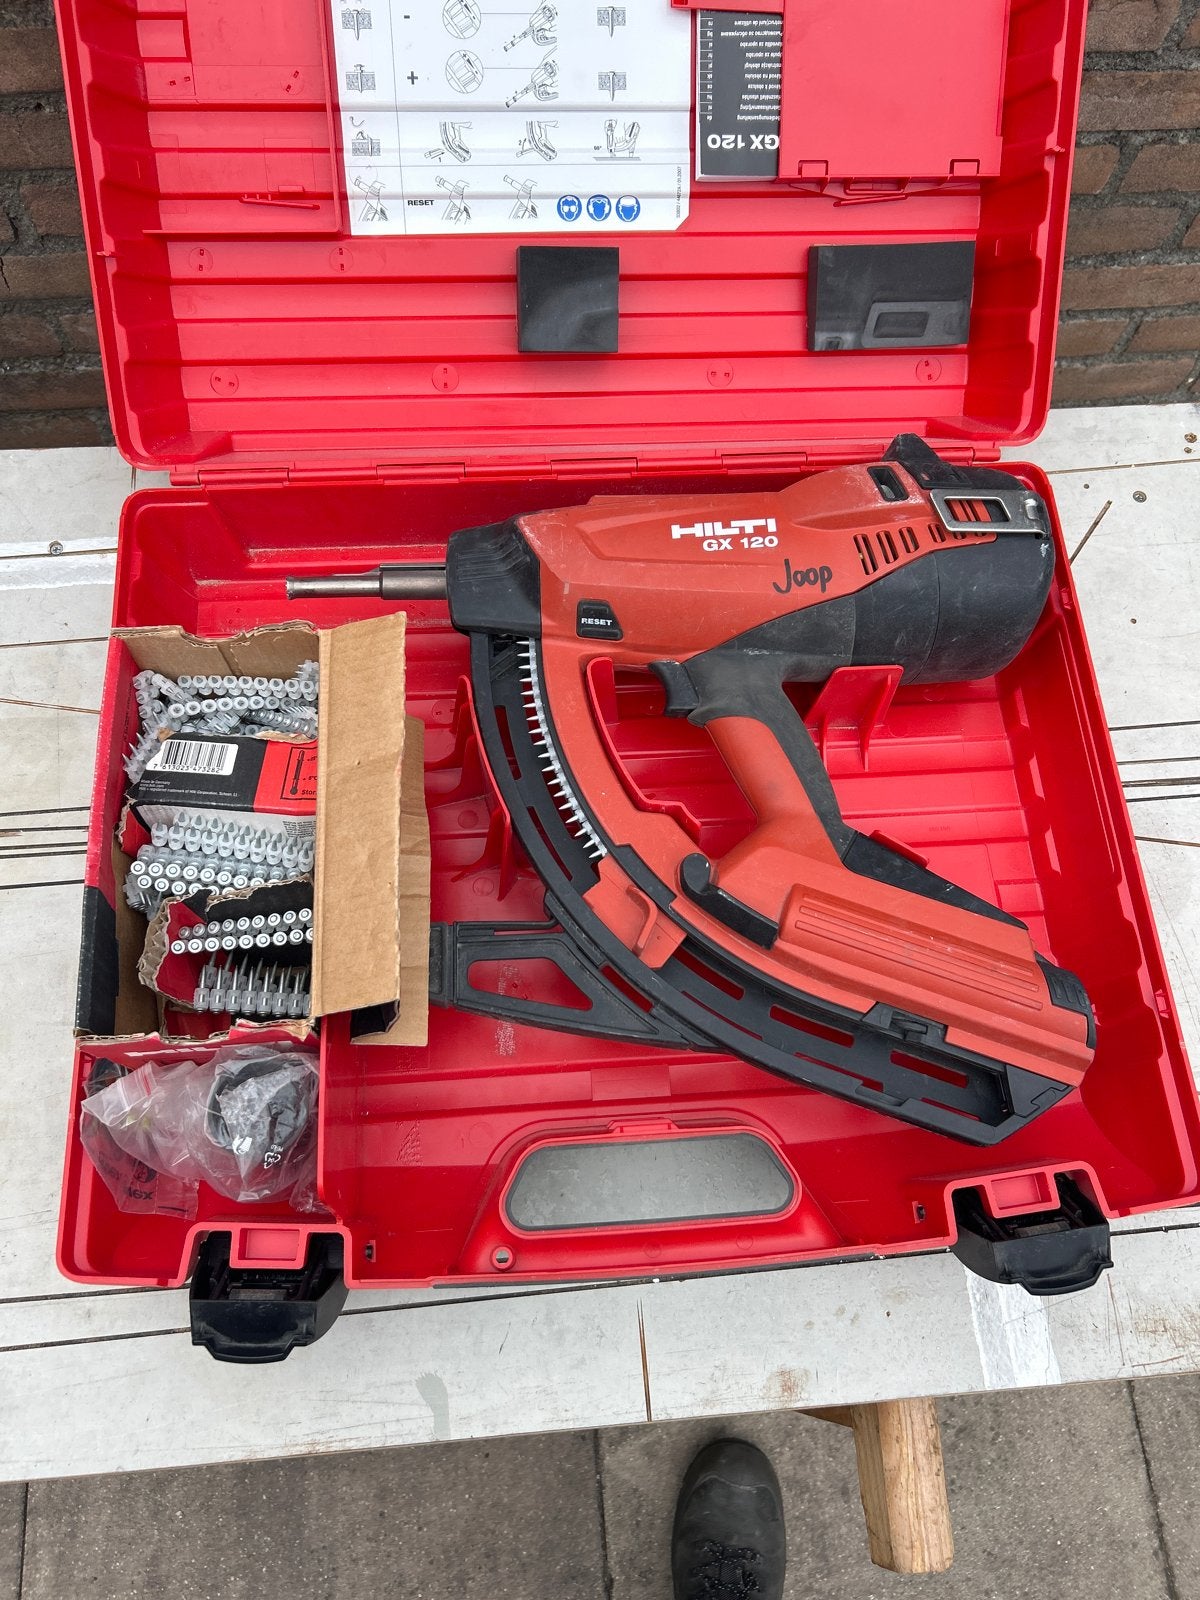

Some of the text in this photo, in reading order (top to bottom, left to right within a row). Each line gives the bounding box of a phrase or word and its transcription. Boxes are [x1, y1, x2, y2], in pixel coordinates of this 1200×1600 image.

[707, 134, 780, 149] GX 120
[670, 518, 777, 540] HILTI
[702, 536, 779, 552] GX 120
[772, 558, 833, 594] Joop
[581, 618, 612, 626] RESET
